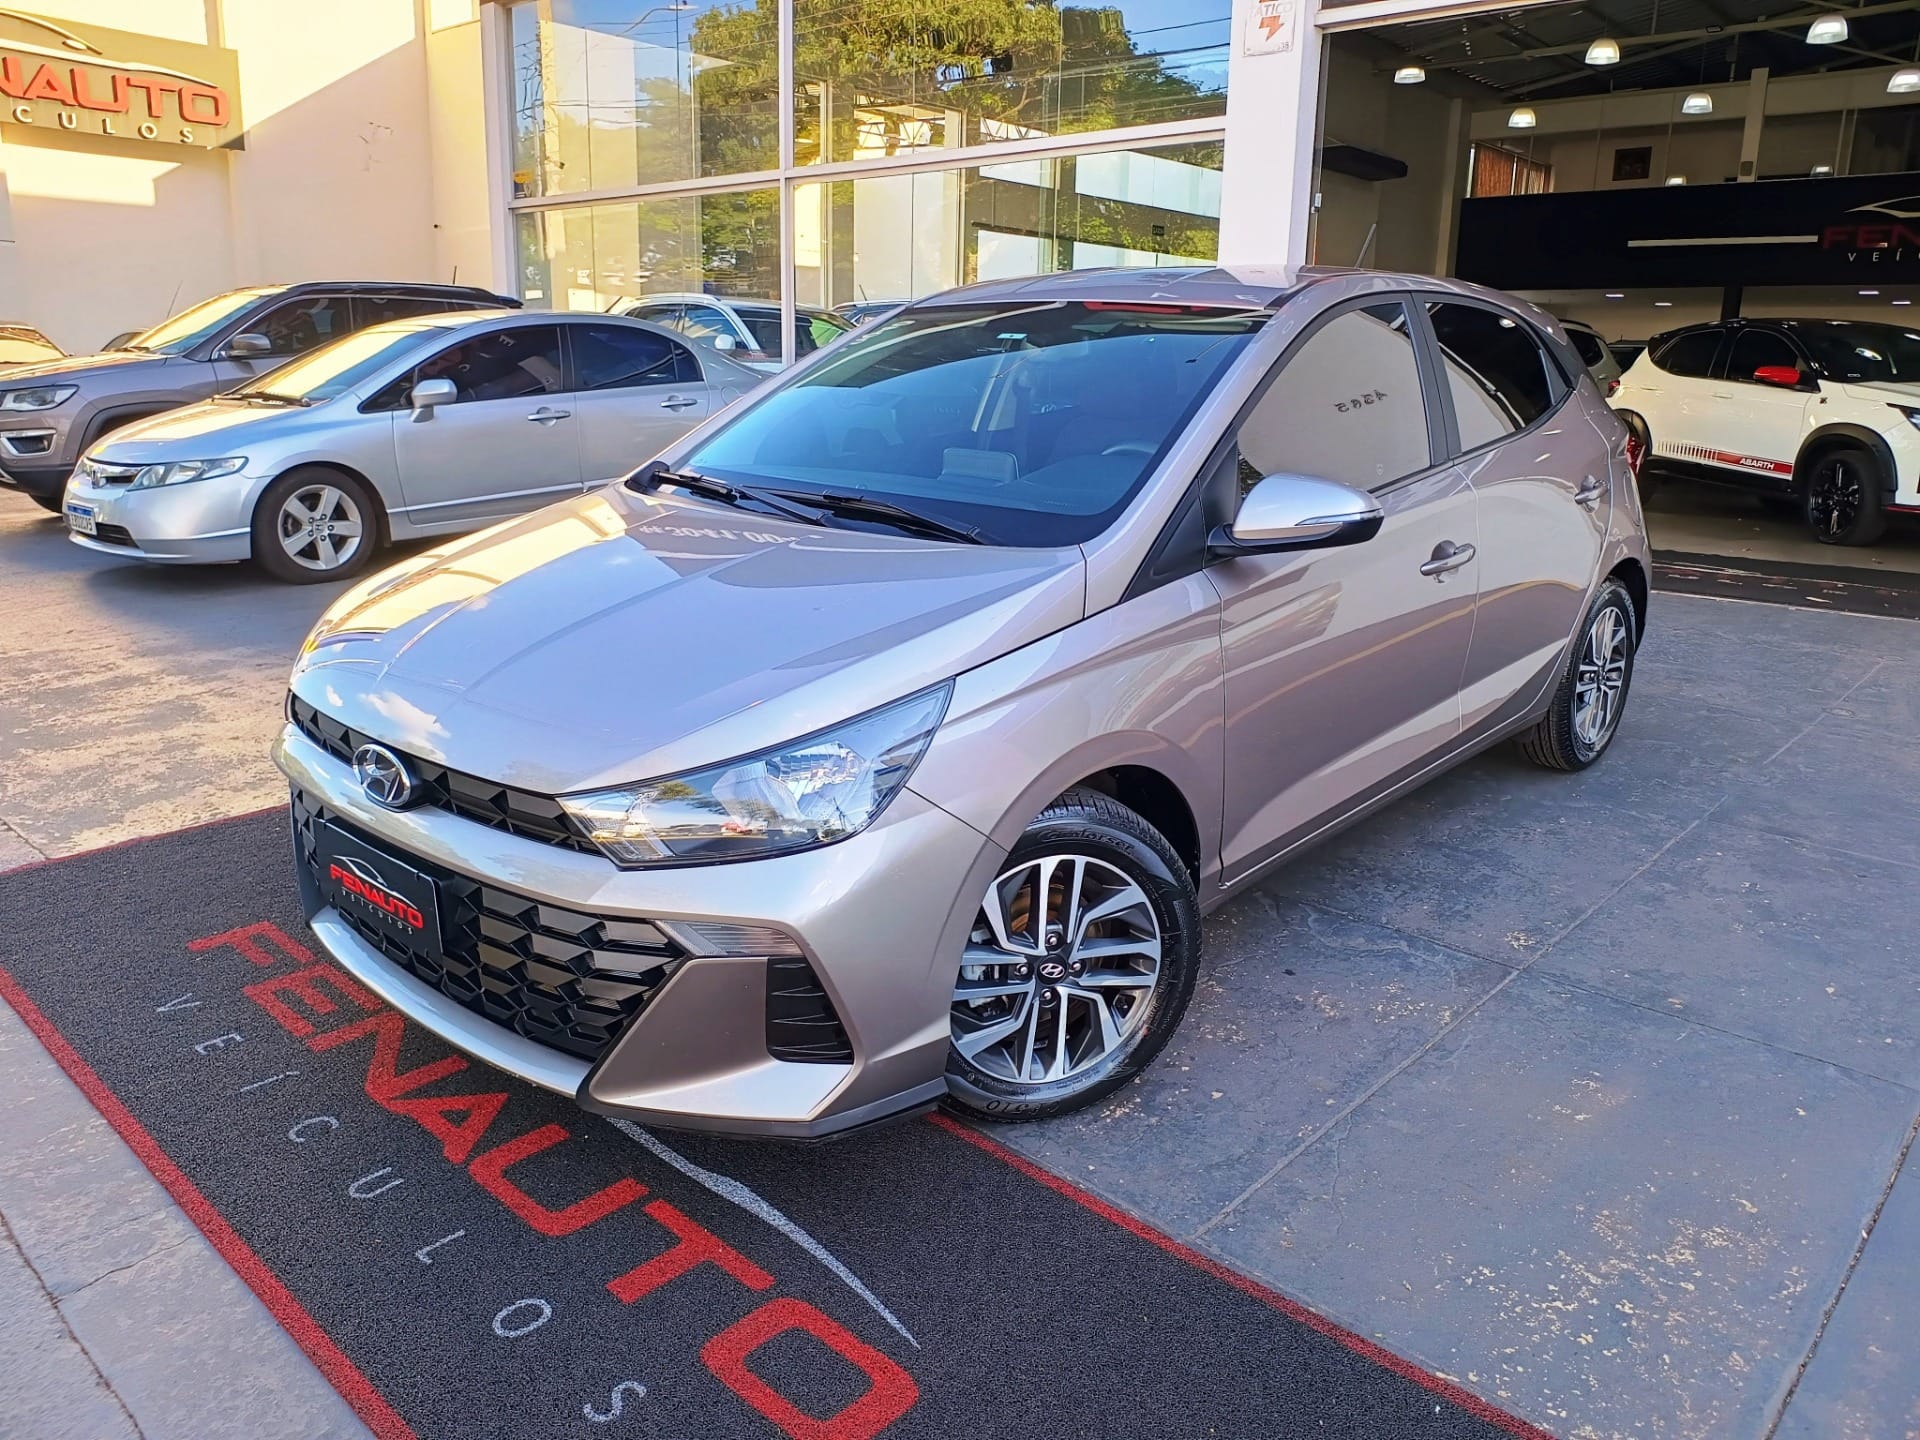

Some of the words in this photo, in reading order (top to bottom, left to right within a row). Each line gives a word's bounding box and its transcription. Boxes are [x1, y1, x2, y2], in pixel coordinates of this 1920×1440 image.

[13, 105, 194, 143] CULOS
[1848, 249, 1920, 262] VEÍ
[1739, 457, 1775, 470] ABARTH
[329, 863, 424, 929] FENAUTO
[187, 920, 919, 1440] FENAUTO
